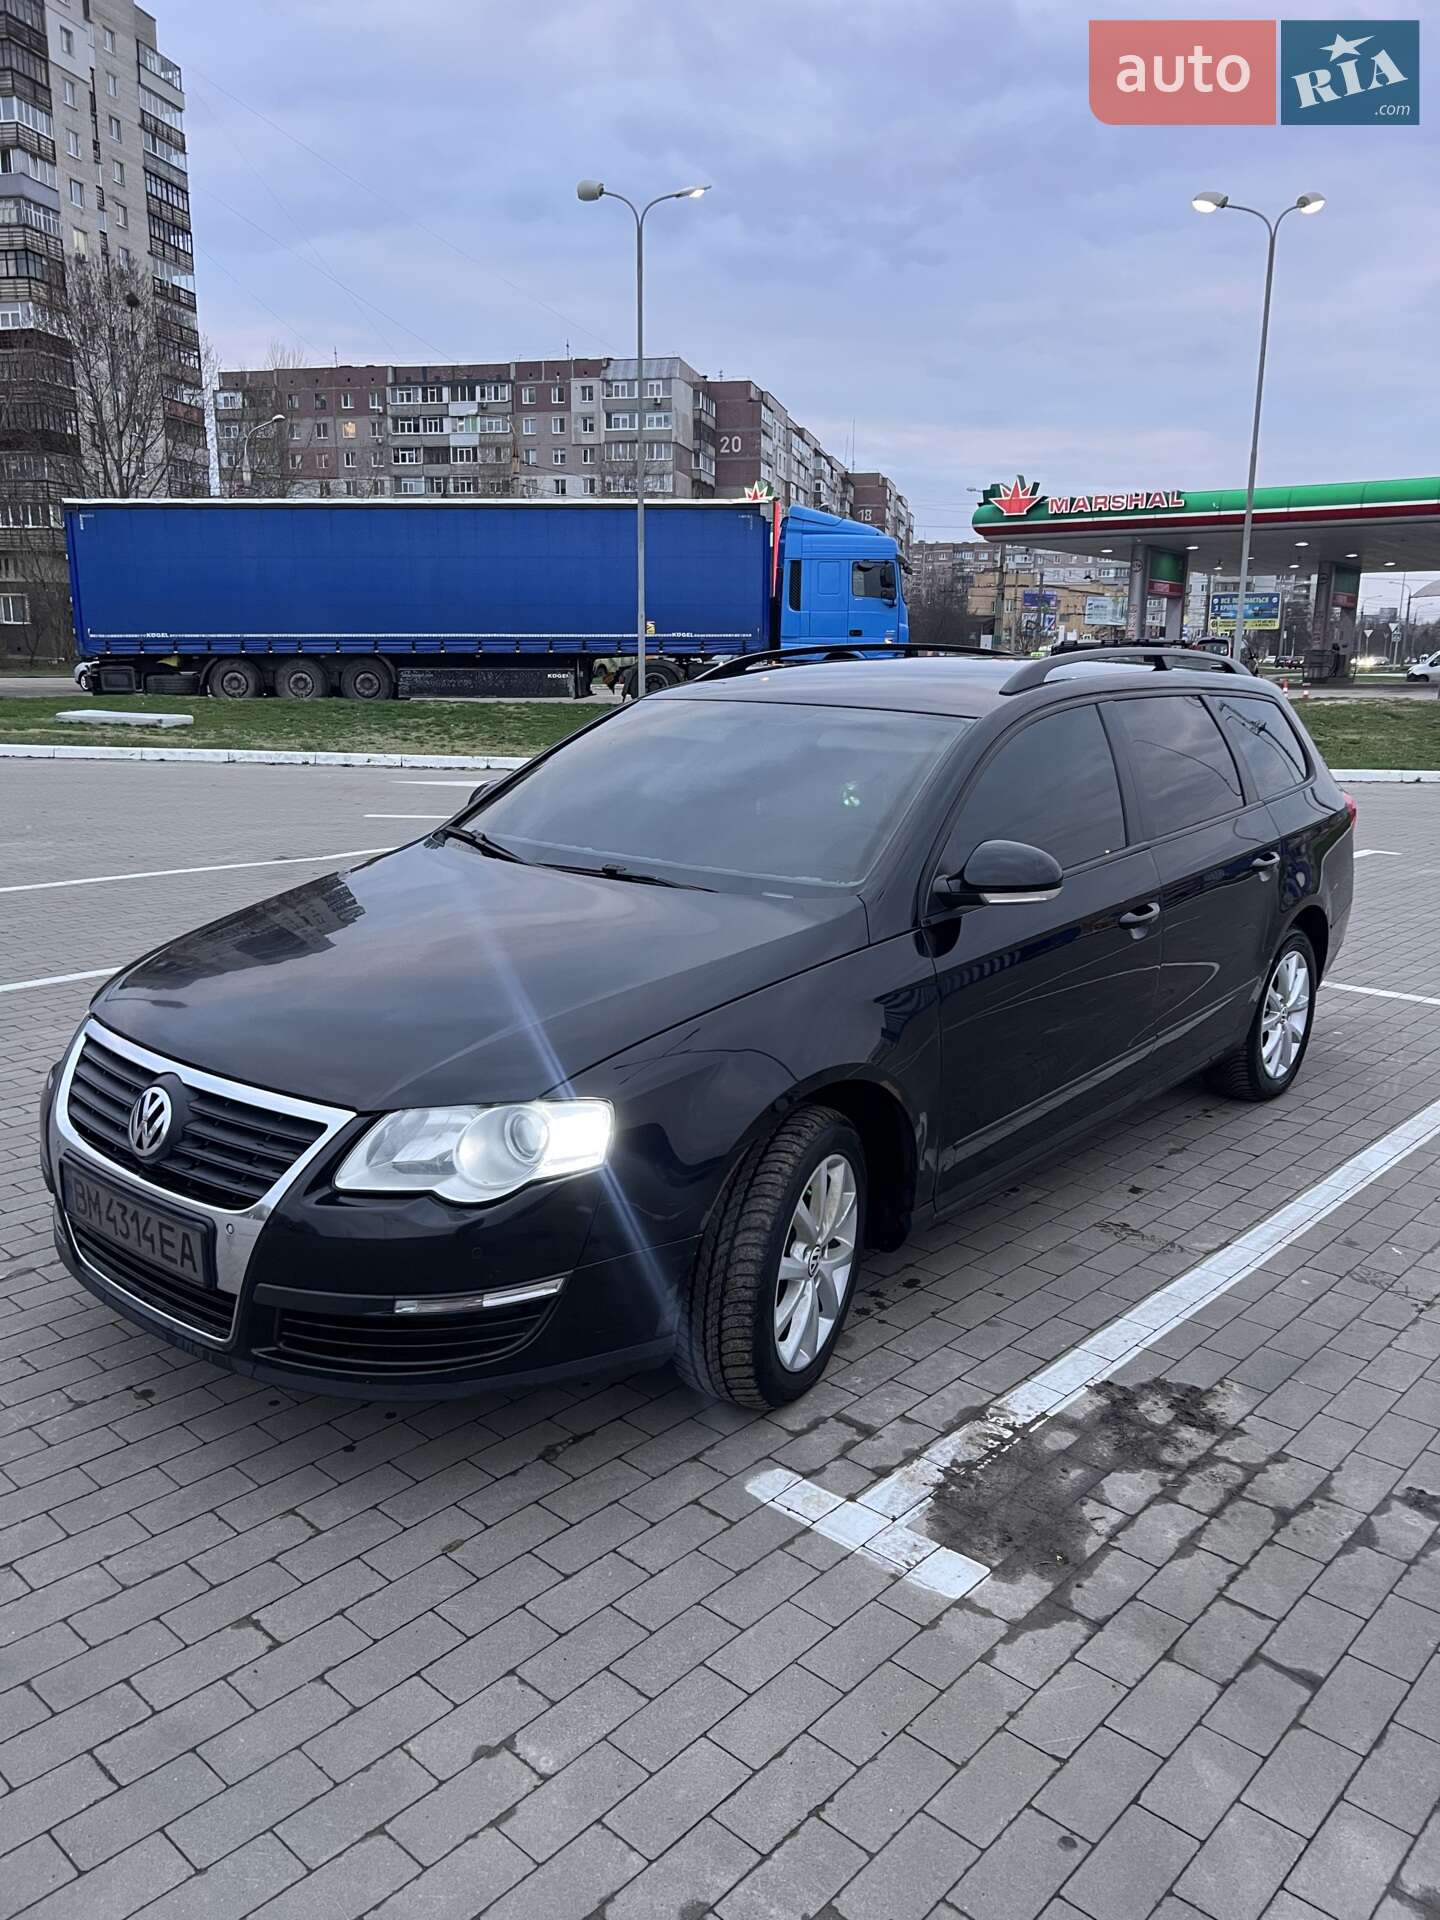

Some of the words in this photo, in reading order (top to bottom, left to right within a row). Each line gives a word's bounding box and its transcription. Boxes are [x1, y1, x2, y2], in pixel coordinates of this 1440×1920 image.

[719, 435, 743, 454] 20
[1048, 490, 1185, 514] MARSHAL
[857, 508, 873, 522] 18
